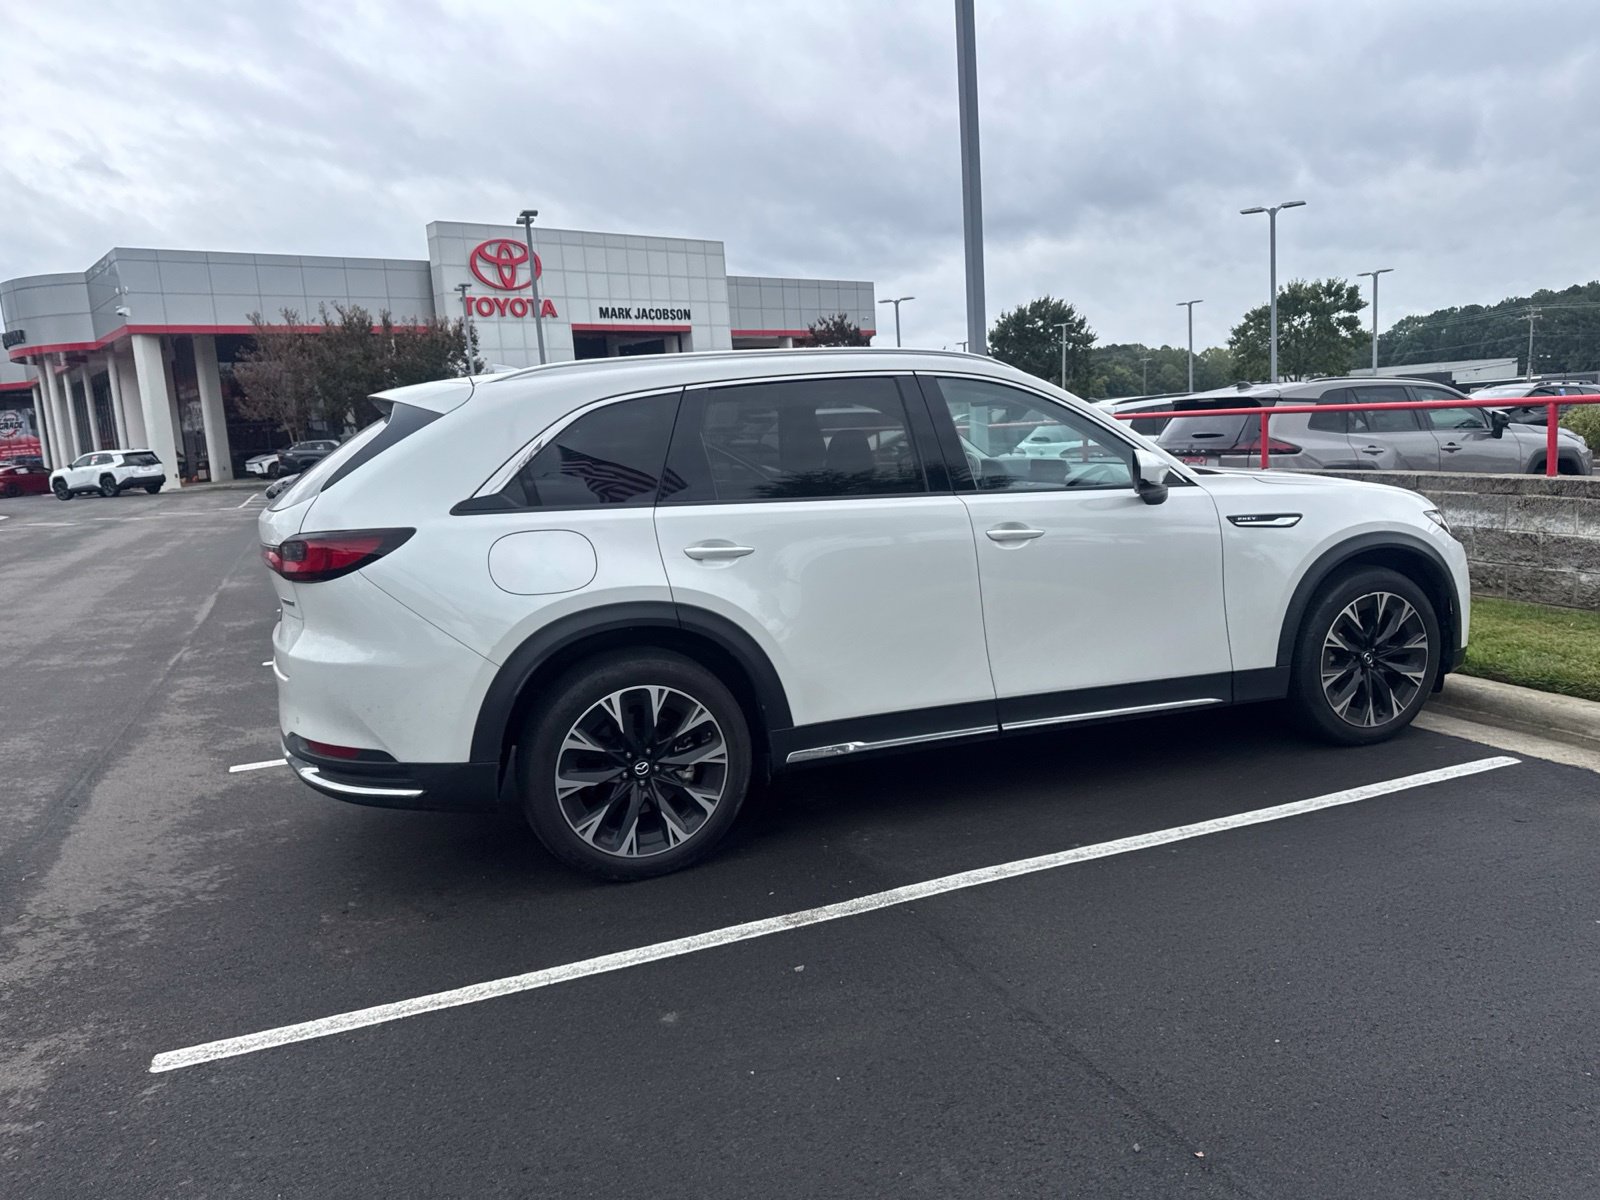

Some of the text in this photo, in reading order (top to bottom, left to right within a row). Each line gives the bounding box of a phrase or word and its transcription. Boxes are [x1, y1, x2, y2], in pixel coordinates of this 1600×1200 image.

[460, 296, 558, 318] TOYOTA
[599, 307, 691, 321] MARK JACOBSON
